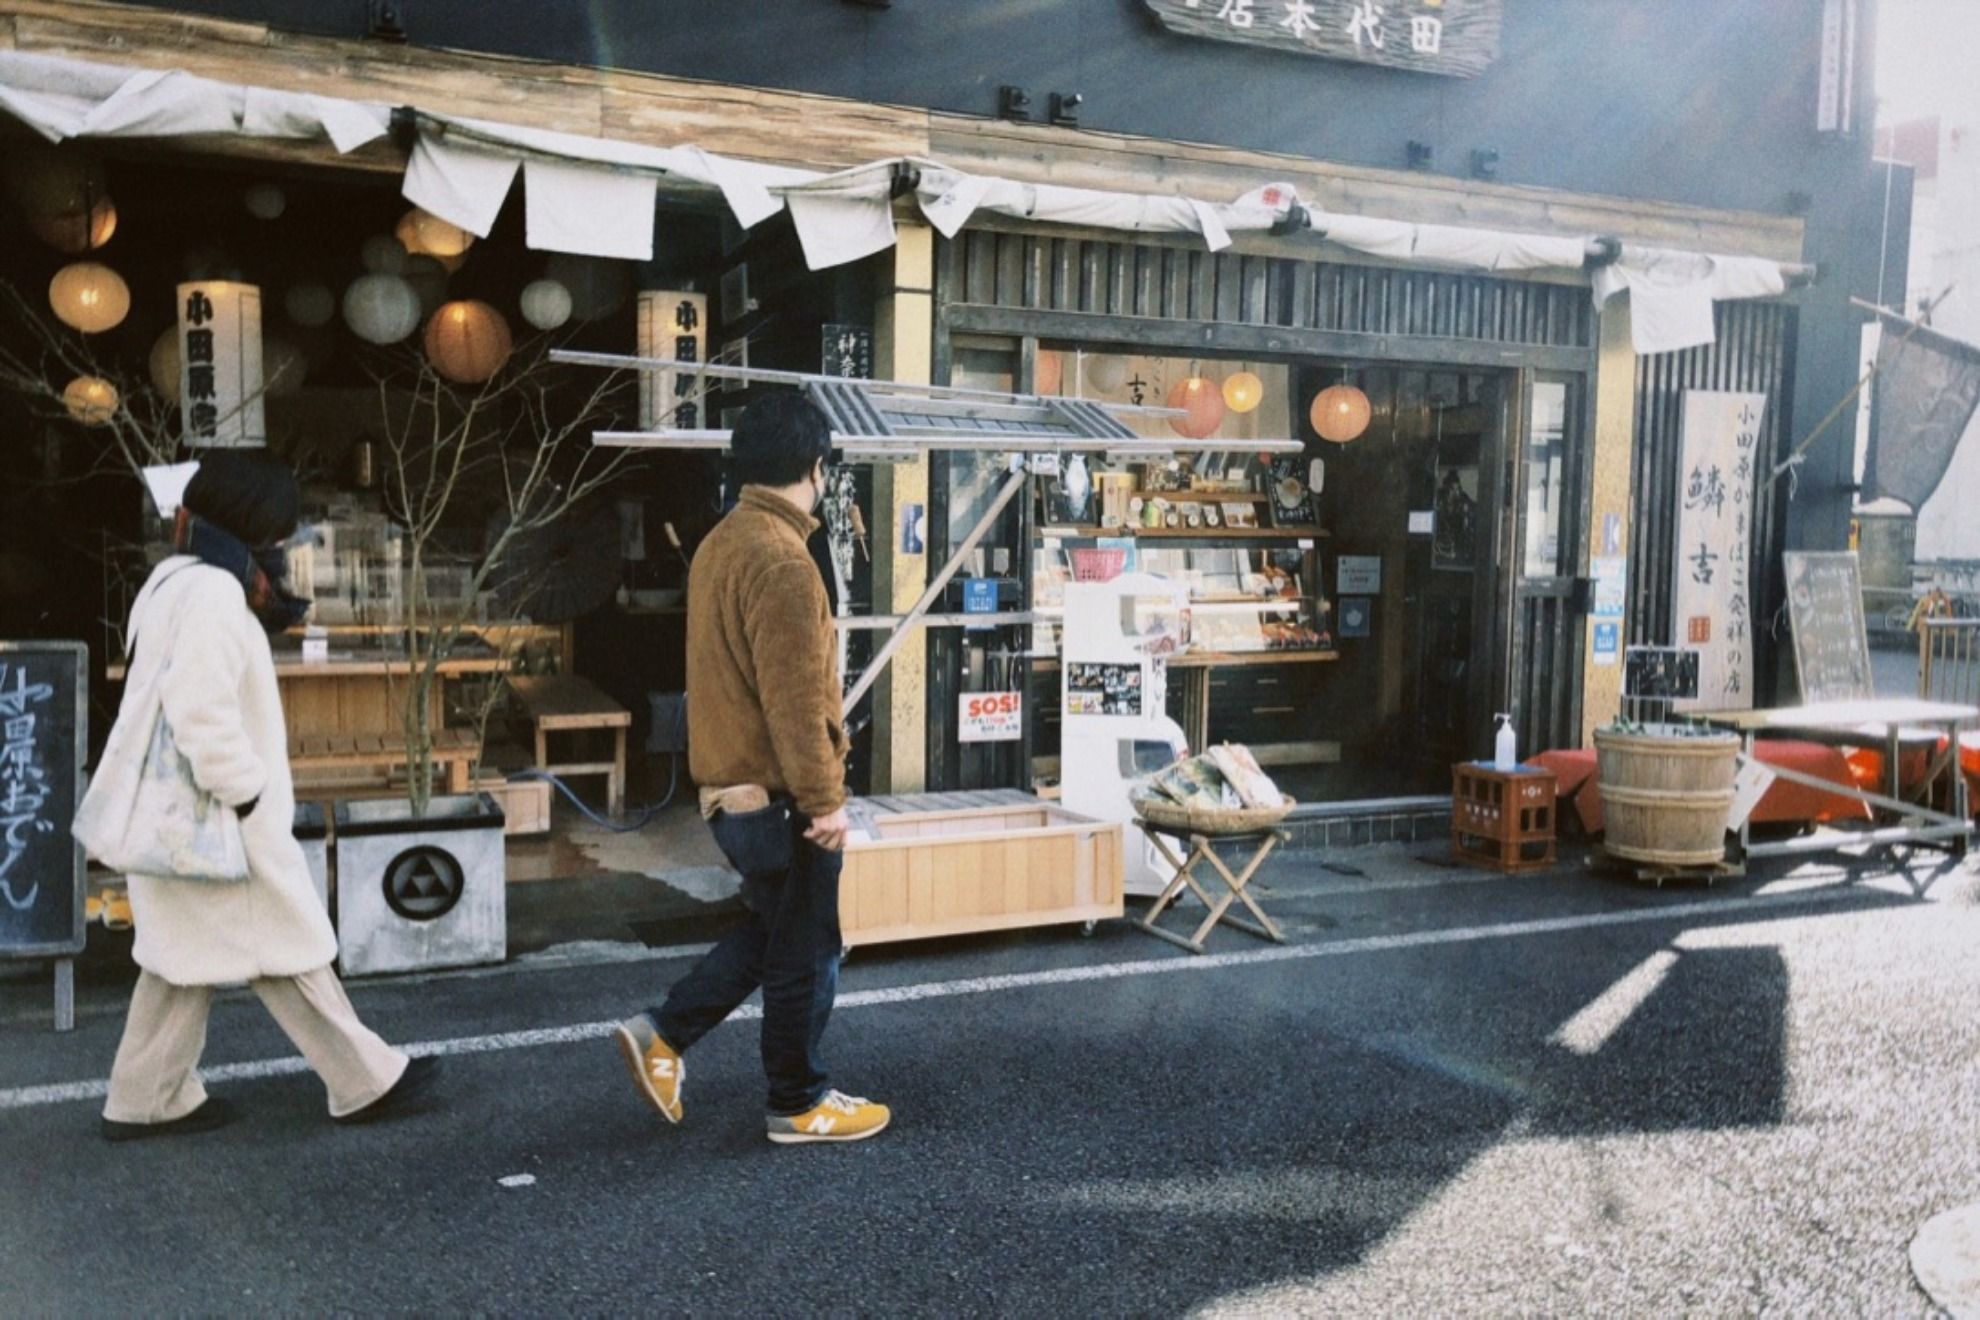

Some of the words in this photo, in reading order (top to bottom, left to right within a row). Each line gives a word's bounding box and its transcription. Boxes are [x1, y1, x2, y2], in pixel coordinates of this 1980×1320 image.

[968, 694, 1019, 717] SOS!
[651, 1057, 674, 1078] N
[807, 1115, 836, 1135] N
